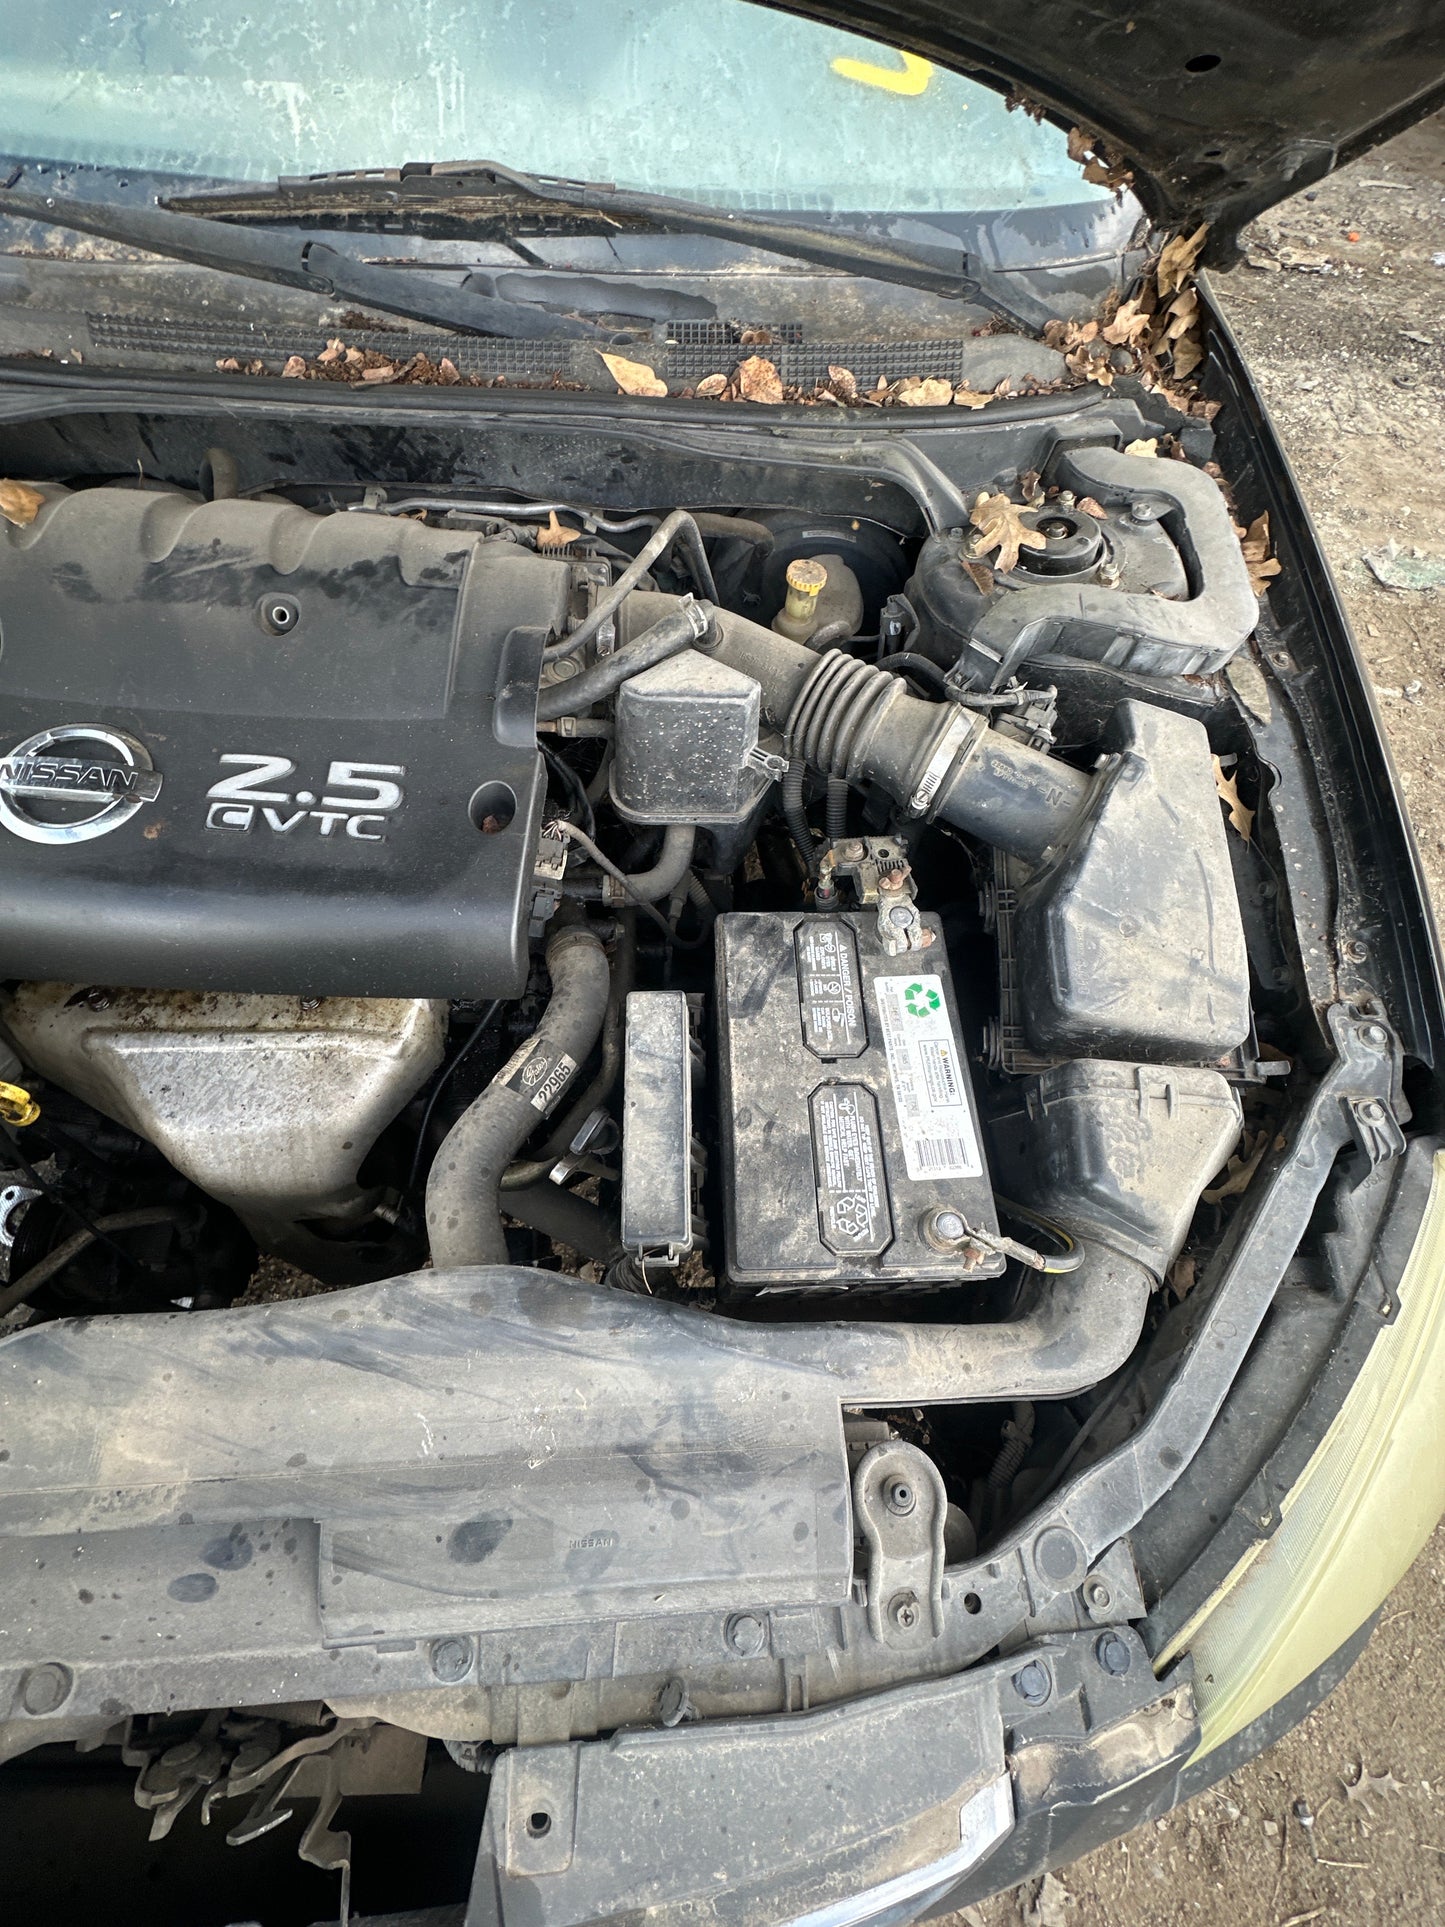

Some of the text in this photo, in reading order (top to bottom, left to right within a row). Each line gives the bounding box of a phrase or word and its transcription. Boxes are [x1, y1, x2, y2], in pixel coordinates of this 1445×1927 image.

[0, 763, 138, 790] NISSAN
[206, 754, 405, 809] 2.5
[840, 953, 851, 985] DANGER
[844, 994, 856, 1026] POISON
[538, 1061, 571, 1102] 22965
[942, 1057, 955, 1096] WARNING:
[1362, 1172, 1385, 1189] USA
[569, 1538, 613, 1549] NISSAN
